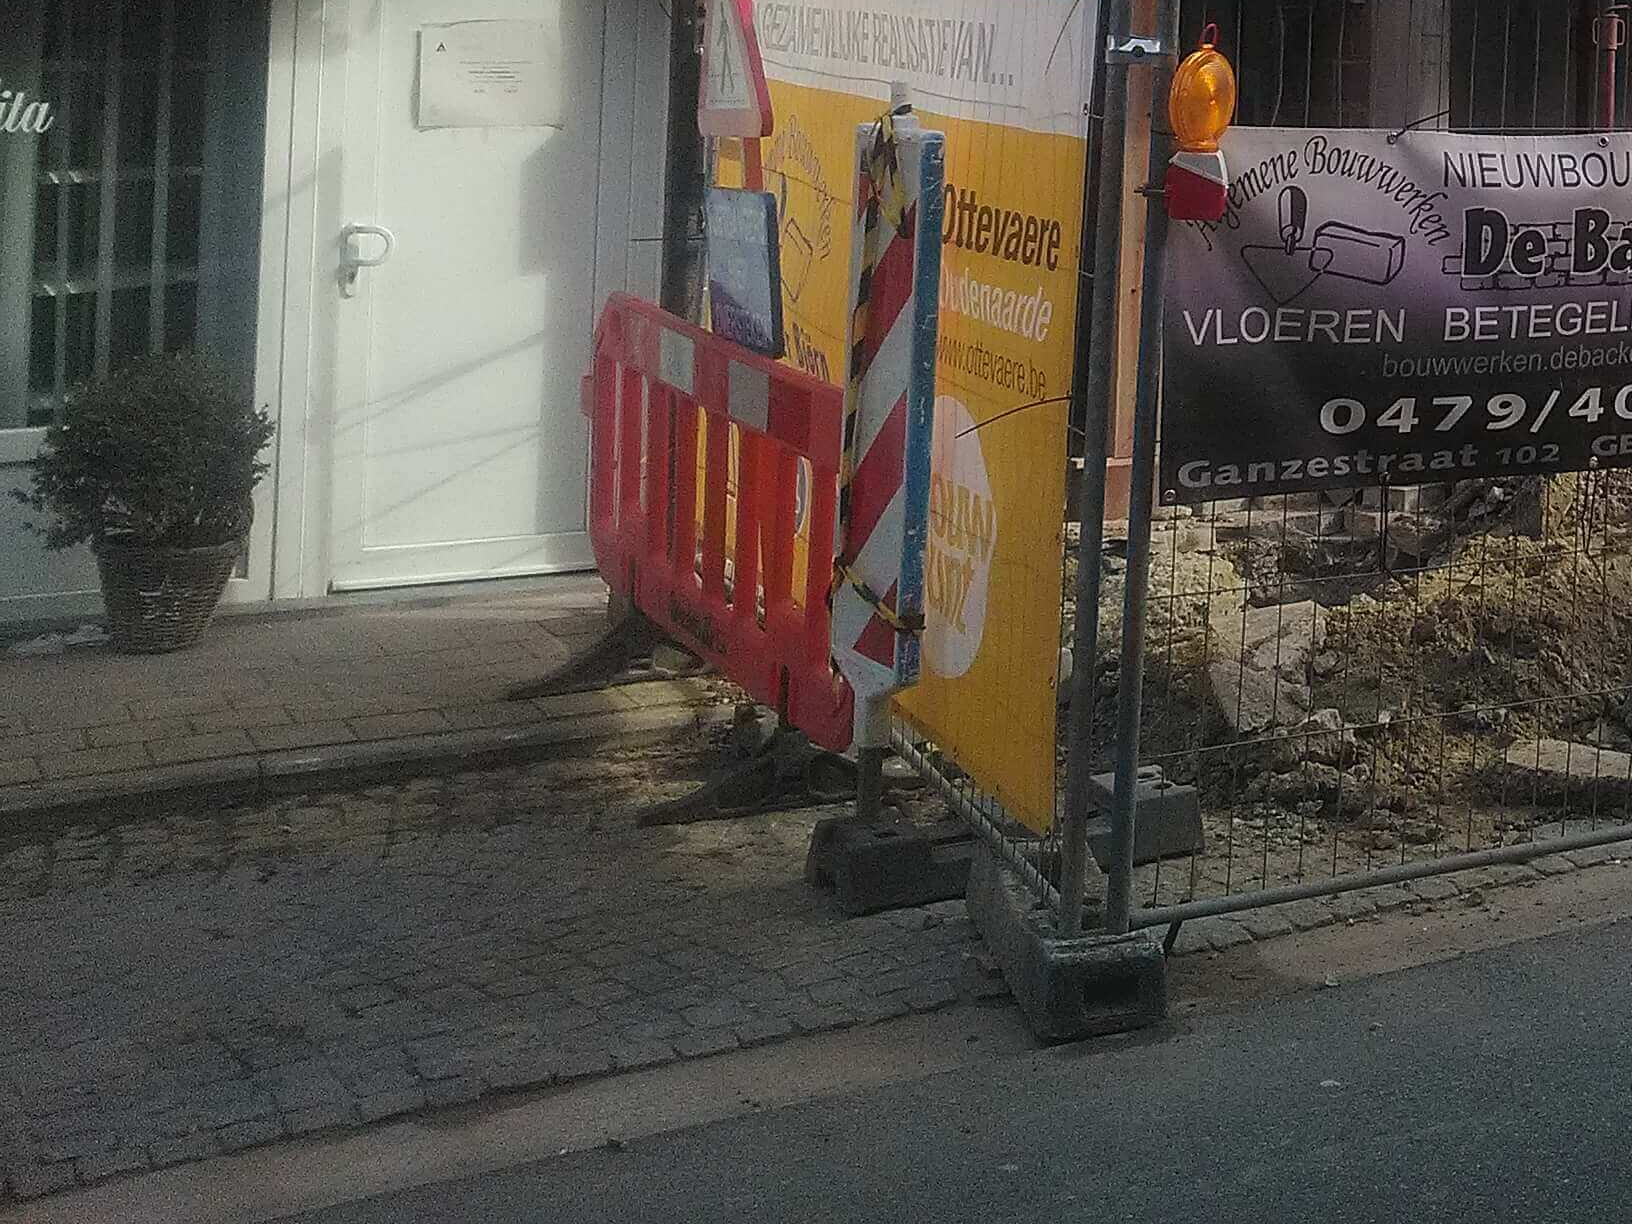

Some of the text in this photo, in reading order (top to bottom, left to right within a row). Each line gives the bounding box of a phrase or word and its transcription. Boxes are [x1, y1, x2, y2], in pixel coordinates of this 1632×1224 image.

[1303, 135, 1451, 247] Bouwwerken
[941, 183, 1062, 272] Ottevaere
[1461, 206, 1548, 278] De
[1183, 306, 1406, 345] VLOEREN
[1177, 443, 1479, 489] Ganzestraat
[1495, 443, 1561, 468] 102
